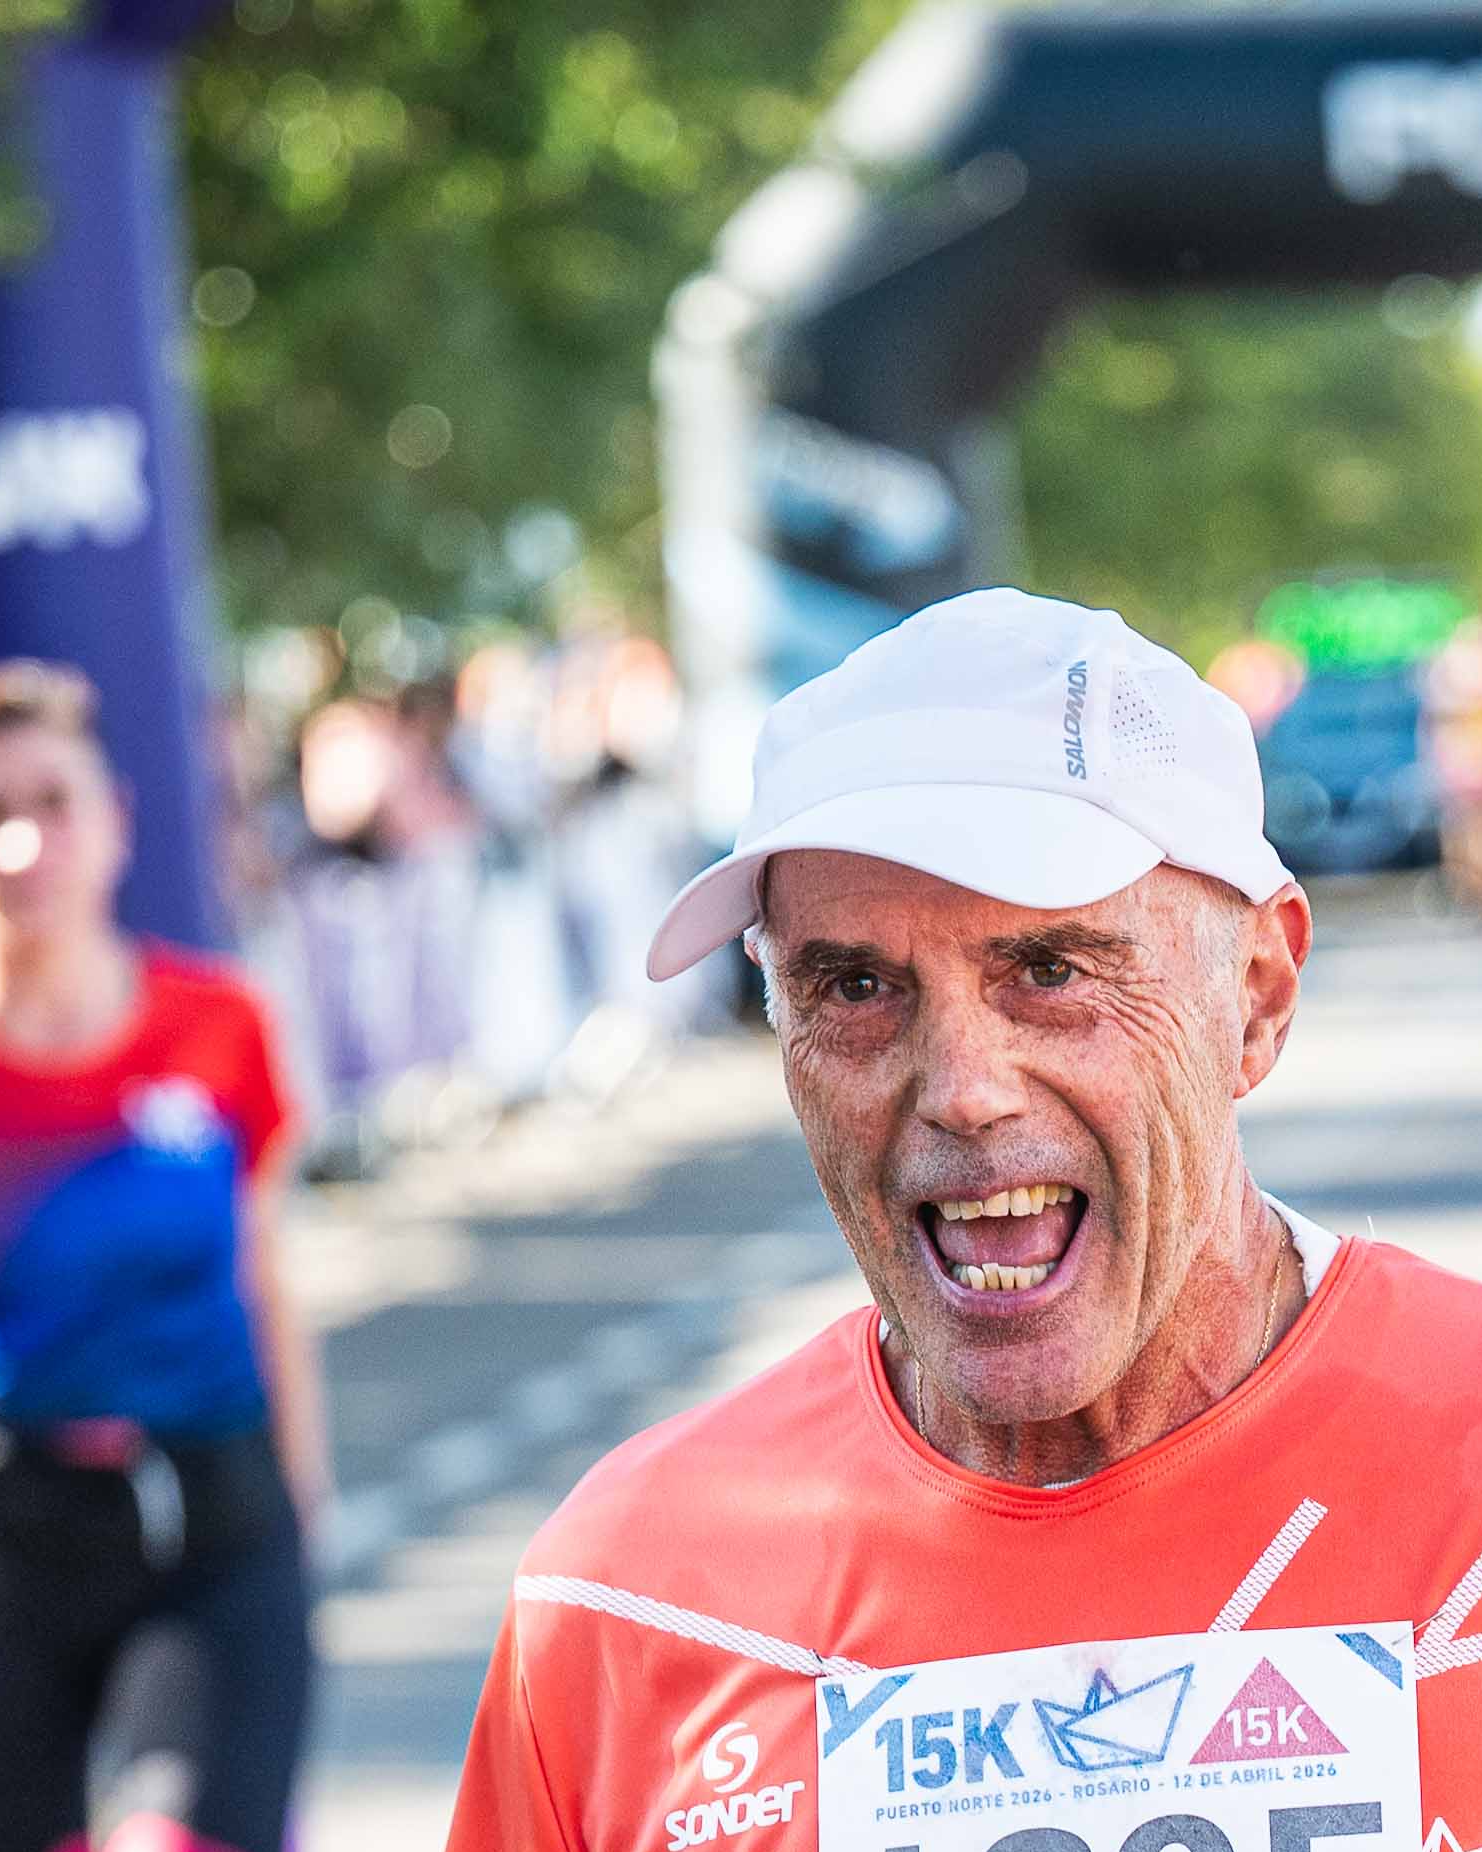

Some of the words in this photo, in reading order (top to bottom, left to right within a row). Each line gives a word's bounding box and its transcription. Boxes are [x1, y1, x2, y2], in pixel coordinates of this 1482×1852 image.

[1064, 659, 1087, 781] SALOMON
[874, 1702, 1025, 1793] 15K
[1225, 1703, 1310, 1749] 15K
[875, 1801, 942, 1822] PUERTO
[948, 1793, 1005, 1814] NORTE
[1011, 1788, 1053, 1809] 2026
[1072, 1778, 1150, 1800] ROSARIO
[1174, 1773, 1193, 1789] 12
[1201, 1771, 1223, 1787] DE
[1230, 1767, 1285, 1785] ABRIL
[1293, 1763, 1337, 1780] 2026
